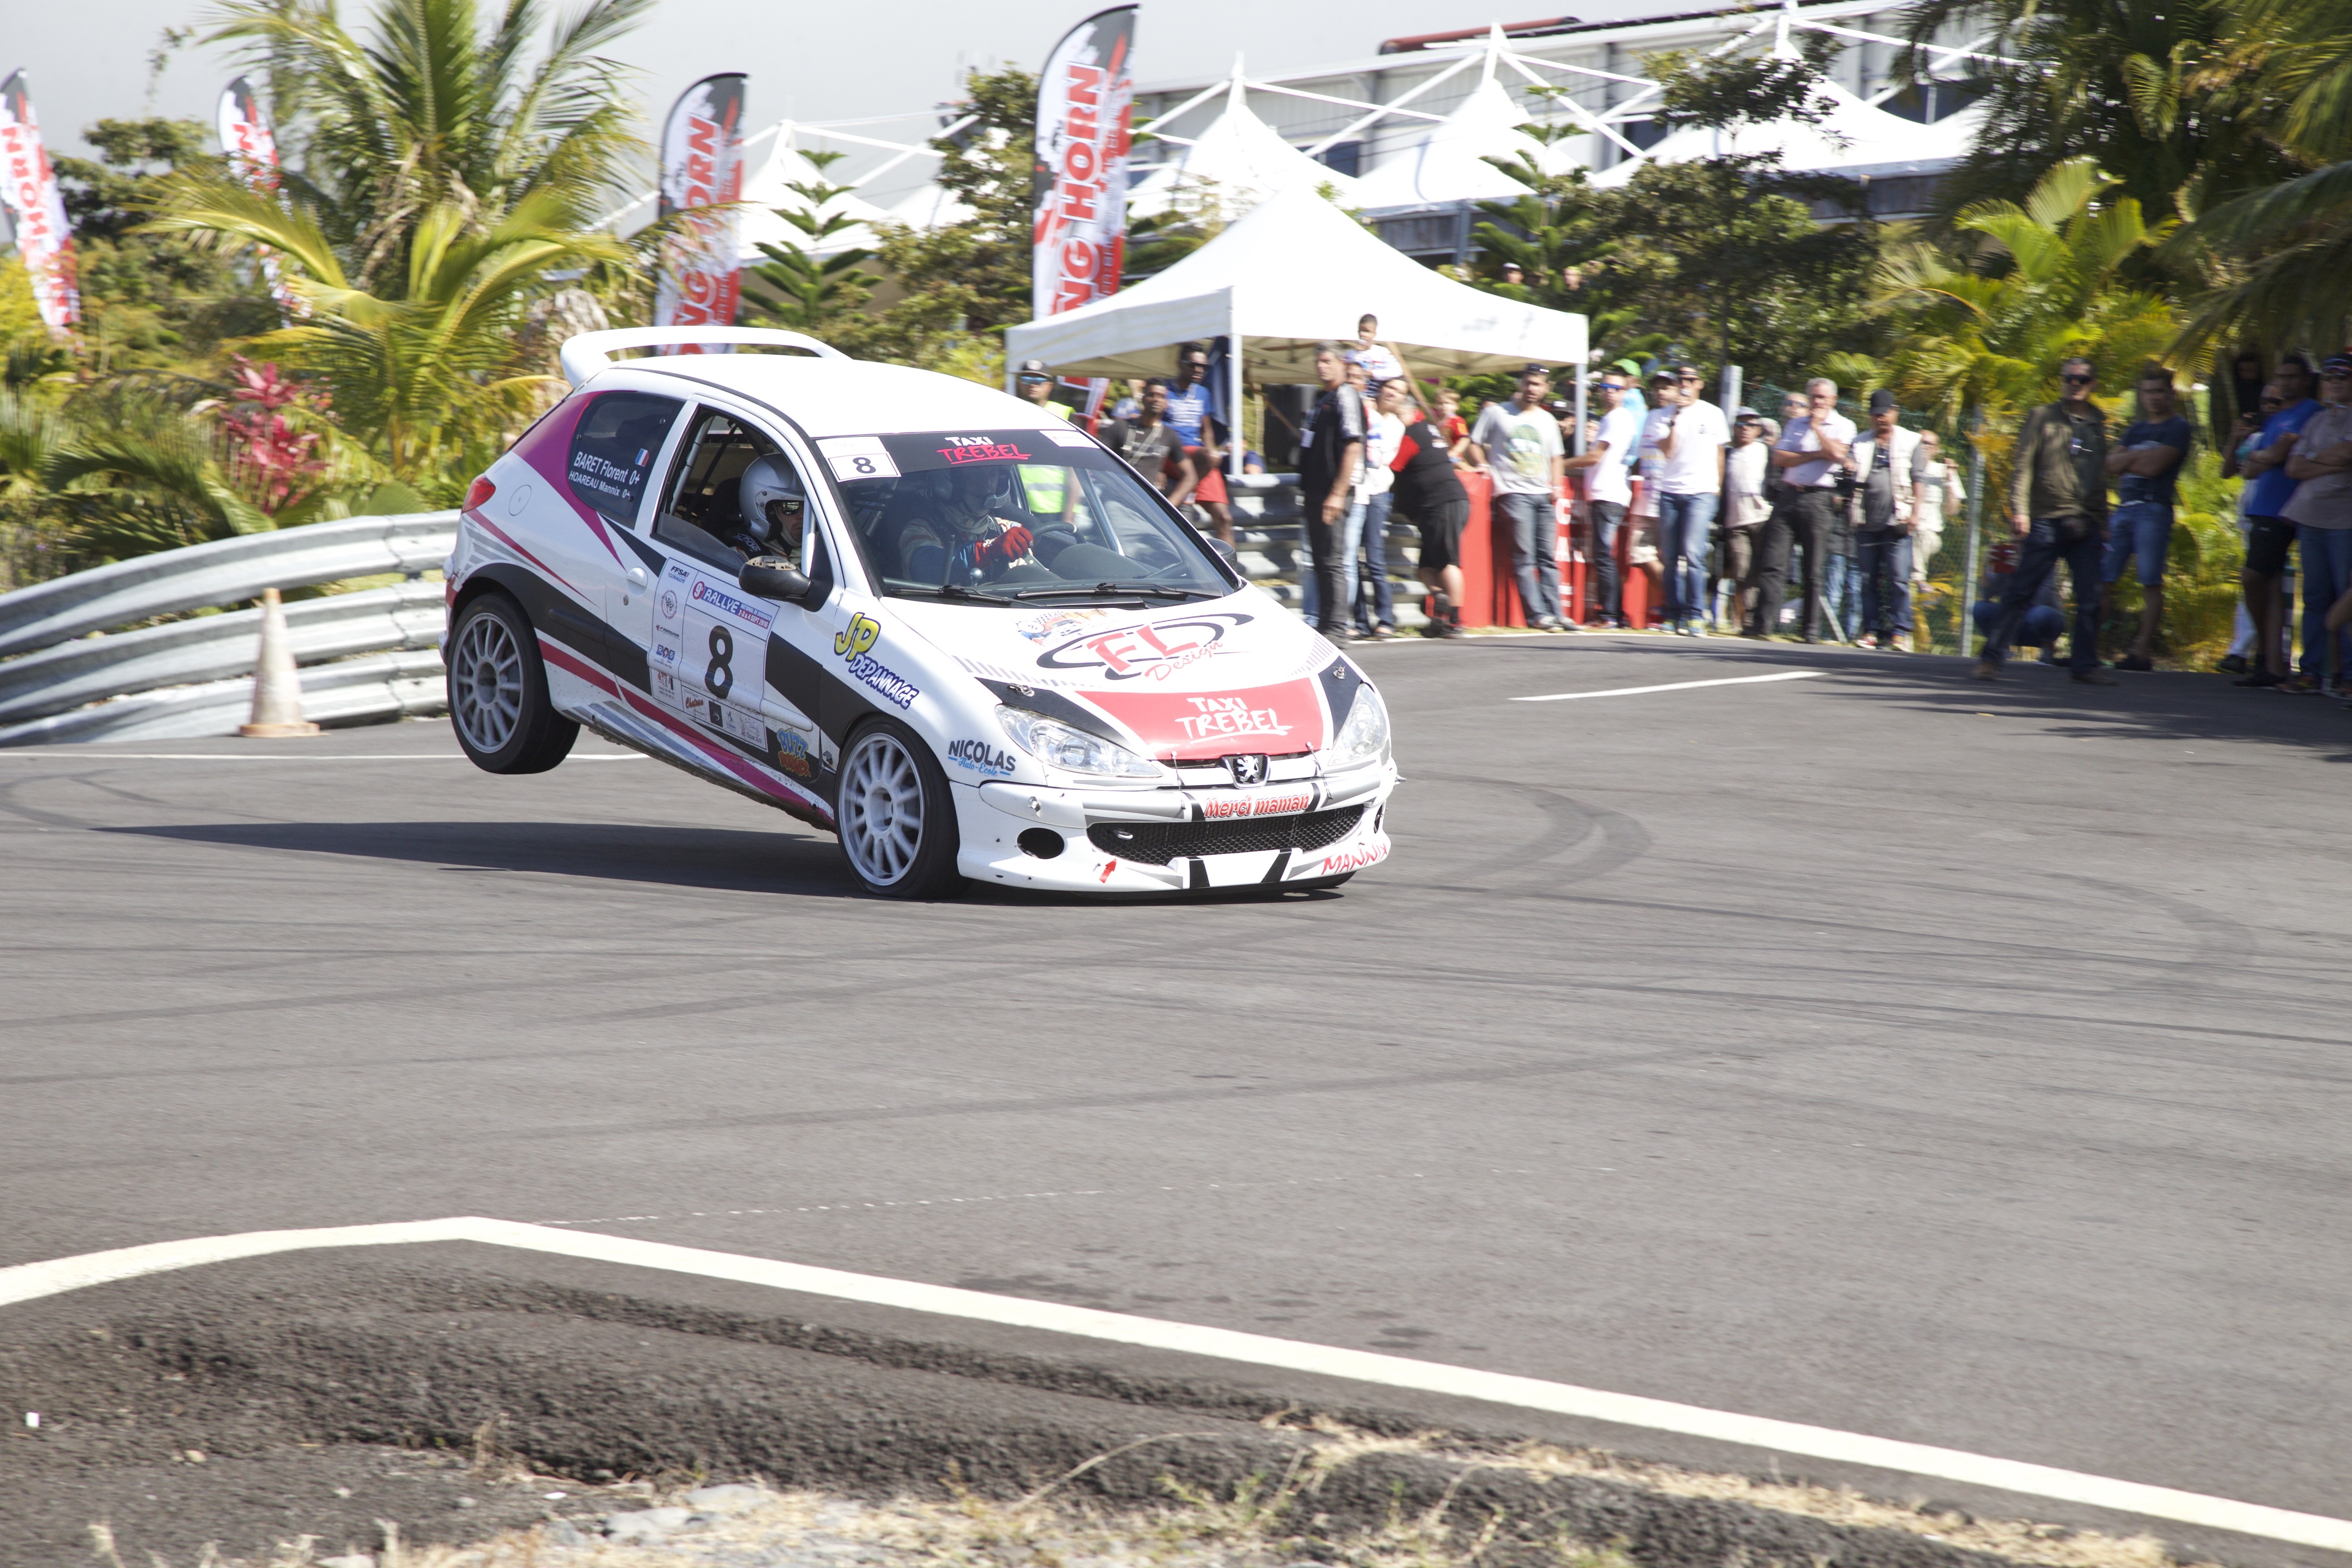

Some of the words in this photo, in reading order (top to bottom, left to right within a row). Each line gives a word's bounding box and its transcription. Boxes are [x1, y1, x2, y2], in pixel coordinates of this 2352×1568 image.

[1060, 61, 1105, 223] HORN
[1, 125, 51, 239] HORN
[937, 443, 1032, 463] TREBEL
[945, 436, 994, 446] TAXI
[573, 451, 603, 473] BARET
[599, 460, 629, 483] Florent
[853, 457, 877, 474] 8
[568, 470, 600, 489] HOAREAU
[598, 480, 621, 497] Mannix
[671, 566, 687, 577] FFSA
[703, 588, 740, 613] RALLYE
[750, 615, 760, 624] SEPT
[834, 612, 881, 662] JP
[1086, 625, 1200, 672] FL
[704, 625, 734, 700] 8
[1144, 642, 1223, 681] Design
[848, 652, 920, 710] DEPANNAGE
[1186, 697, 1248, 712] TAXI
[1174, 708, 1294, 741] TREBEL
[777, 727, 809, 760] BUZZ
[948, 740, 1016, 772] NICOLAS
[958, 756, 998, 777] Auto-Ecole
[1204, 795, 1252, 818] Merci
[1254, 793, 1310, 816] maman
[1321, 843, 1388, 875] MANNIX
